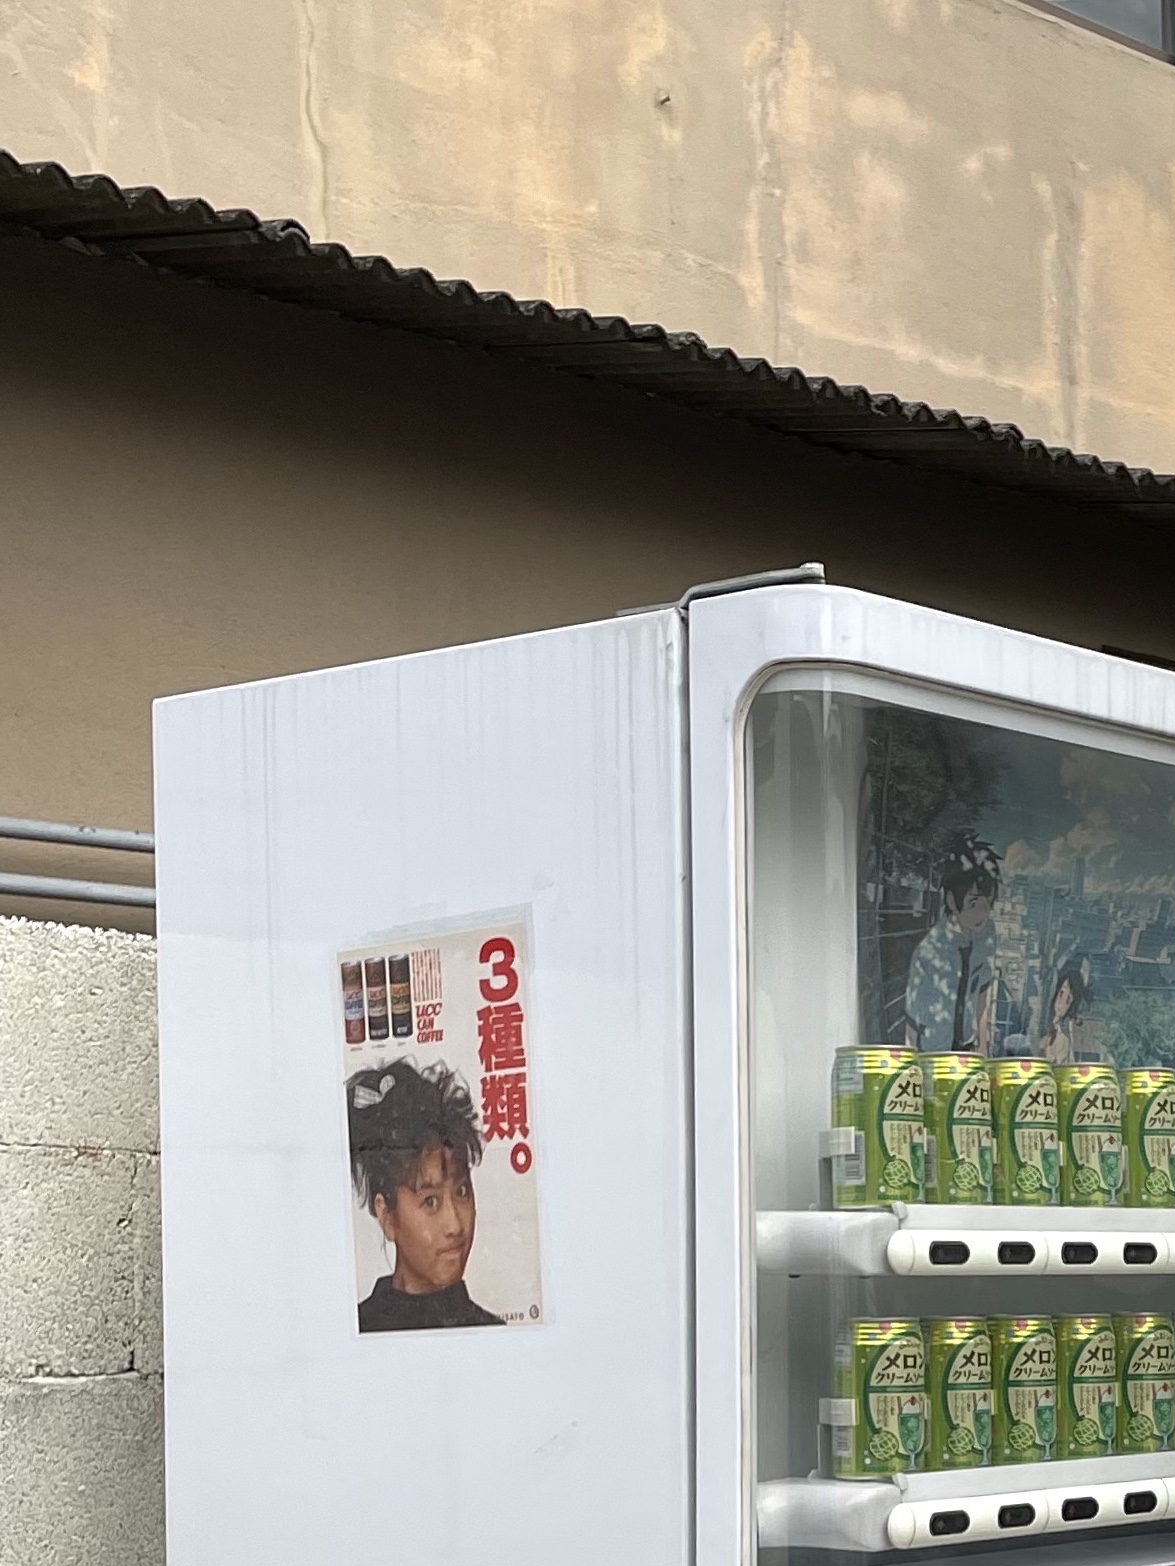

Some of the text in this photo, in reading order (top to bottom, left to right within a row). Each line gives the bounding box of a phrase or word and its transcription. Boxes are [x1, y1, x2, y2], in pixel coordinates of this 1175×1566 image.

[475, 937, 533, 1175] 3種類。
[1019, 1109, 1056, 1120] クリーム
[952, 1370, 991, 1381] クリーム
